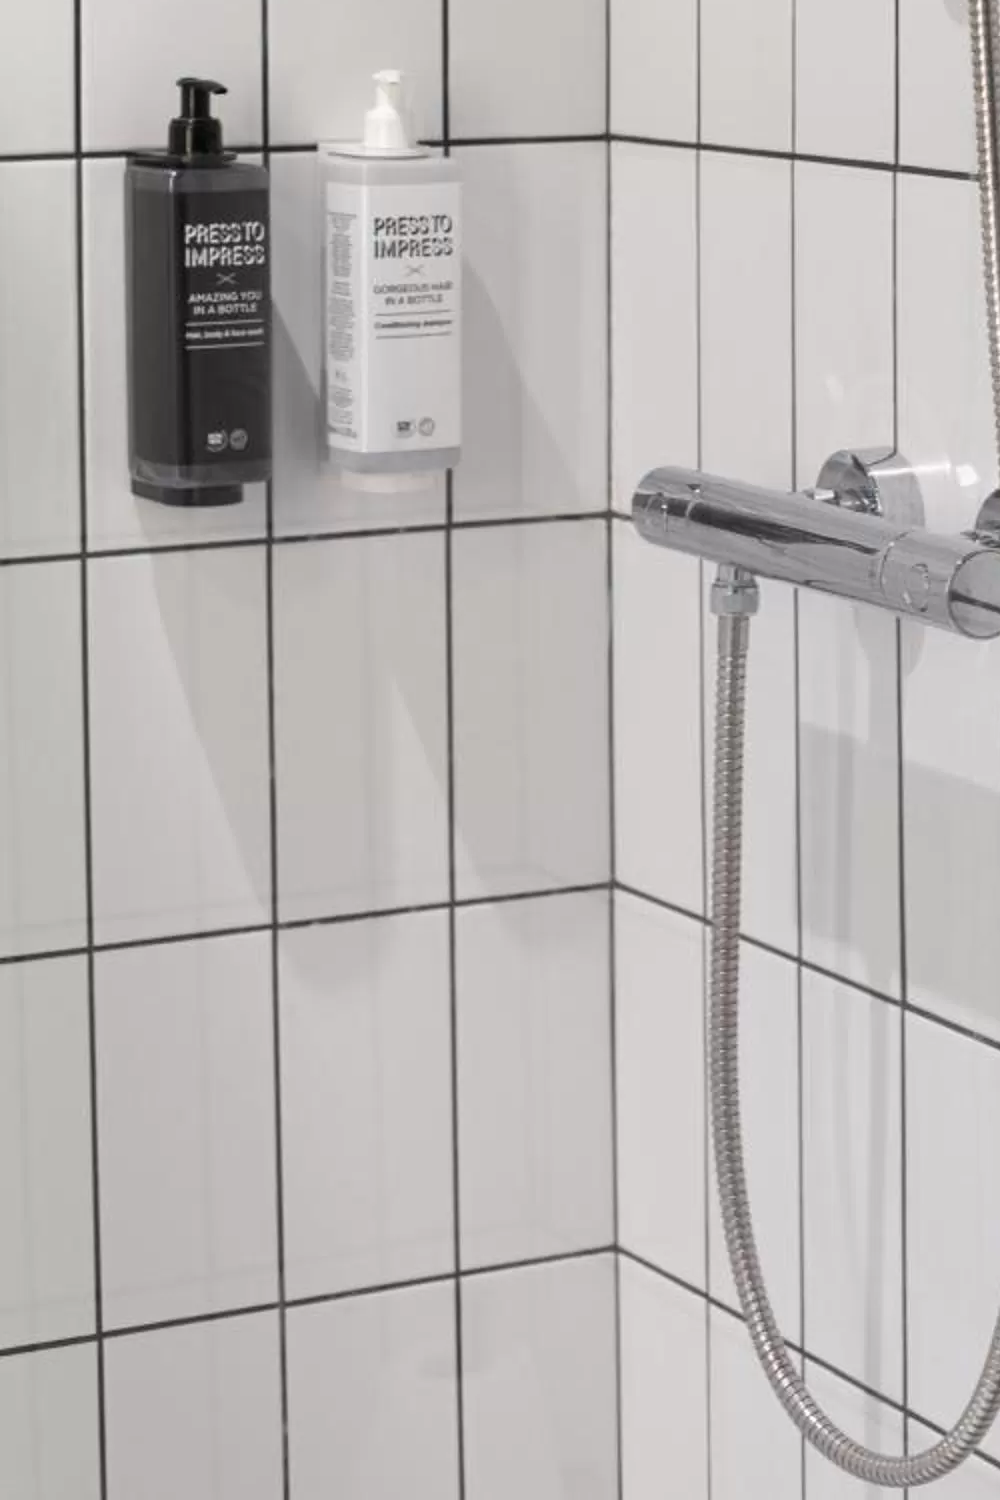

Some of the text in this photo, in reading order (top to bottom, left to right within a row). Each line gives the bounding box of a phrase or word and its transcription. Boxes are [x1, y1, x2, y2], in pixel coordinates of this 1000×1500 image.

[184, 221, 265, 244] PRESS TO
[373, 214, 453, 236] PRESS TO
[184, 244, 265, 267] IMPRESS
[373, 237, 453, 259] IMPRESS
[188, 292, 239, 304] AMAZING
[207, 304, 216, 314] A
[217, 302, 257, 315] BOTTLE
